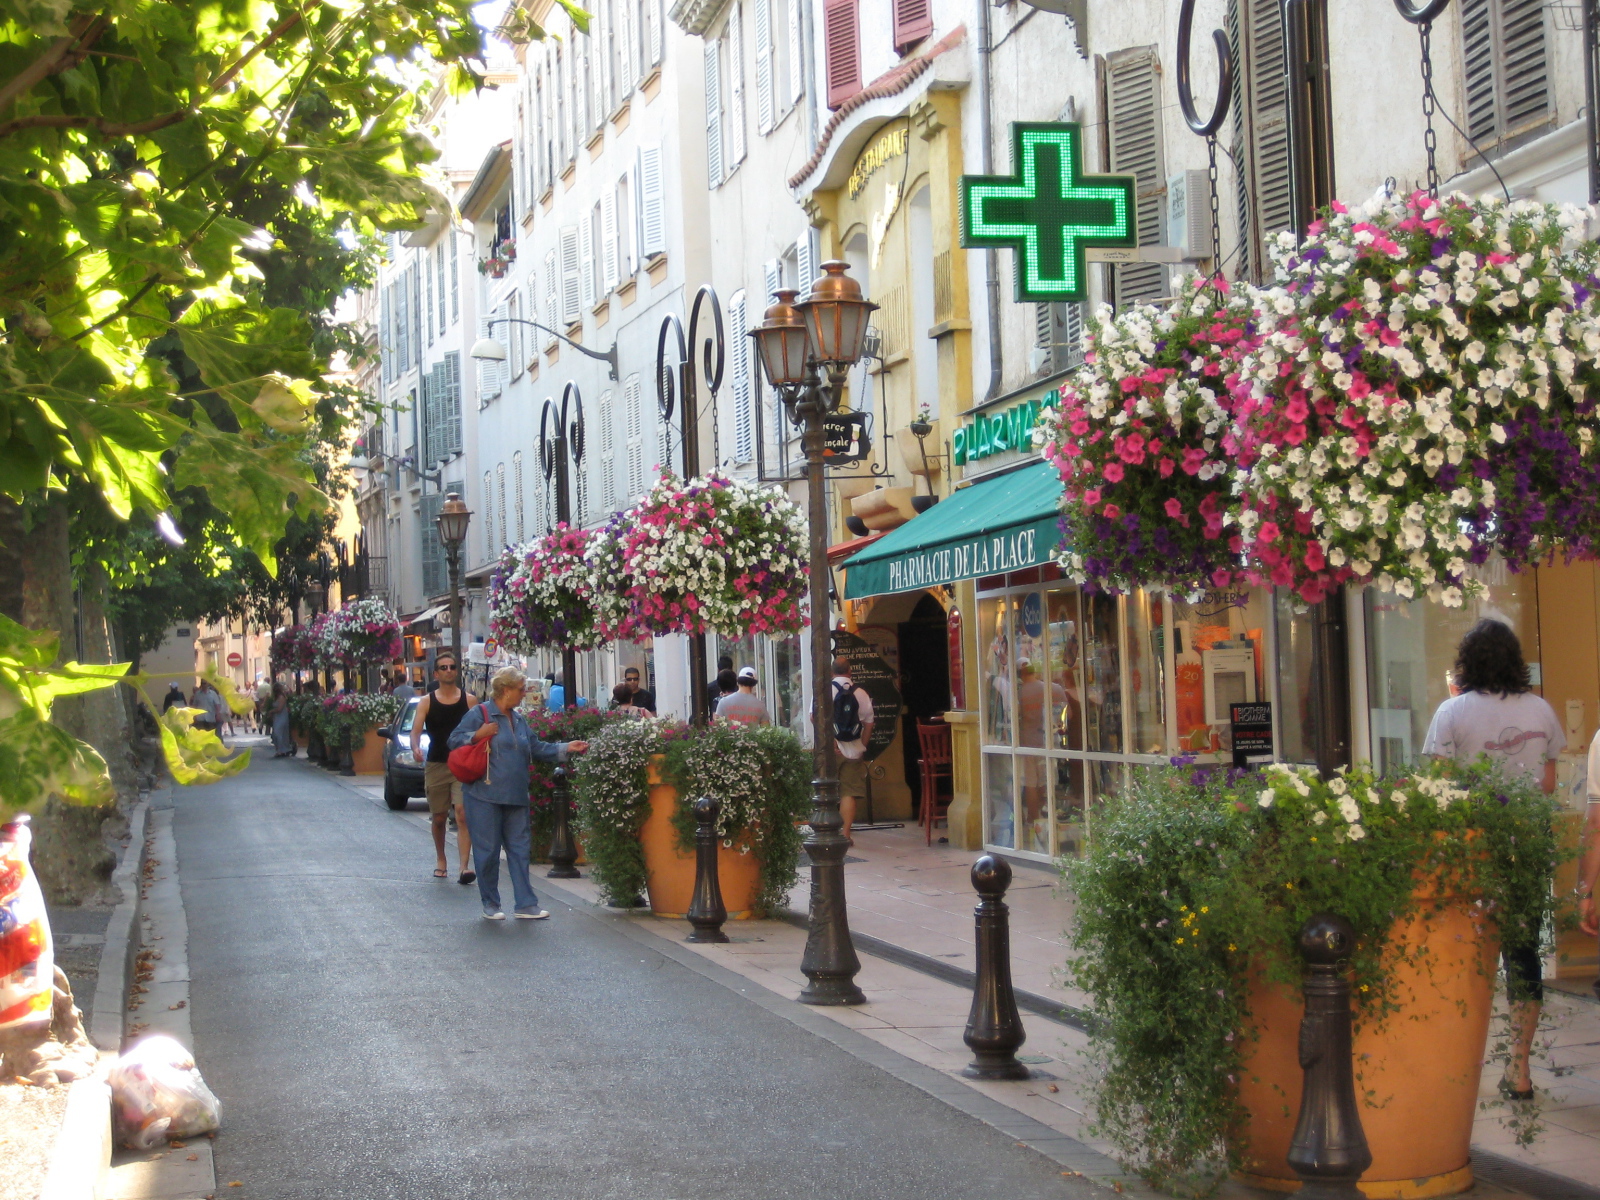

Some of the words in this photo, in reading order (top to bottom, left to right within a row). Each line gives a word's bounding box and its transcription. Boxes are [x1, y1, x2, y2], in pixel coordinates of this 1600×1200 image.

[848, 128, 908, 198] RESTAURANT
[889, 549, 951, 591] PHARMACIE
[954, 544, 970, 578] DE
[973, 540, 990, 574] LA
[992, 528, 1036, 571] PLACE
[1183, 670, 1199, 680] 20
[1237, 706, 1271, 715] BIOTHERM
[1238, 713, 1266, 722] HOMME
